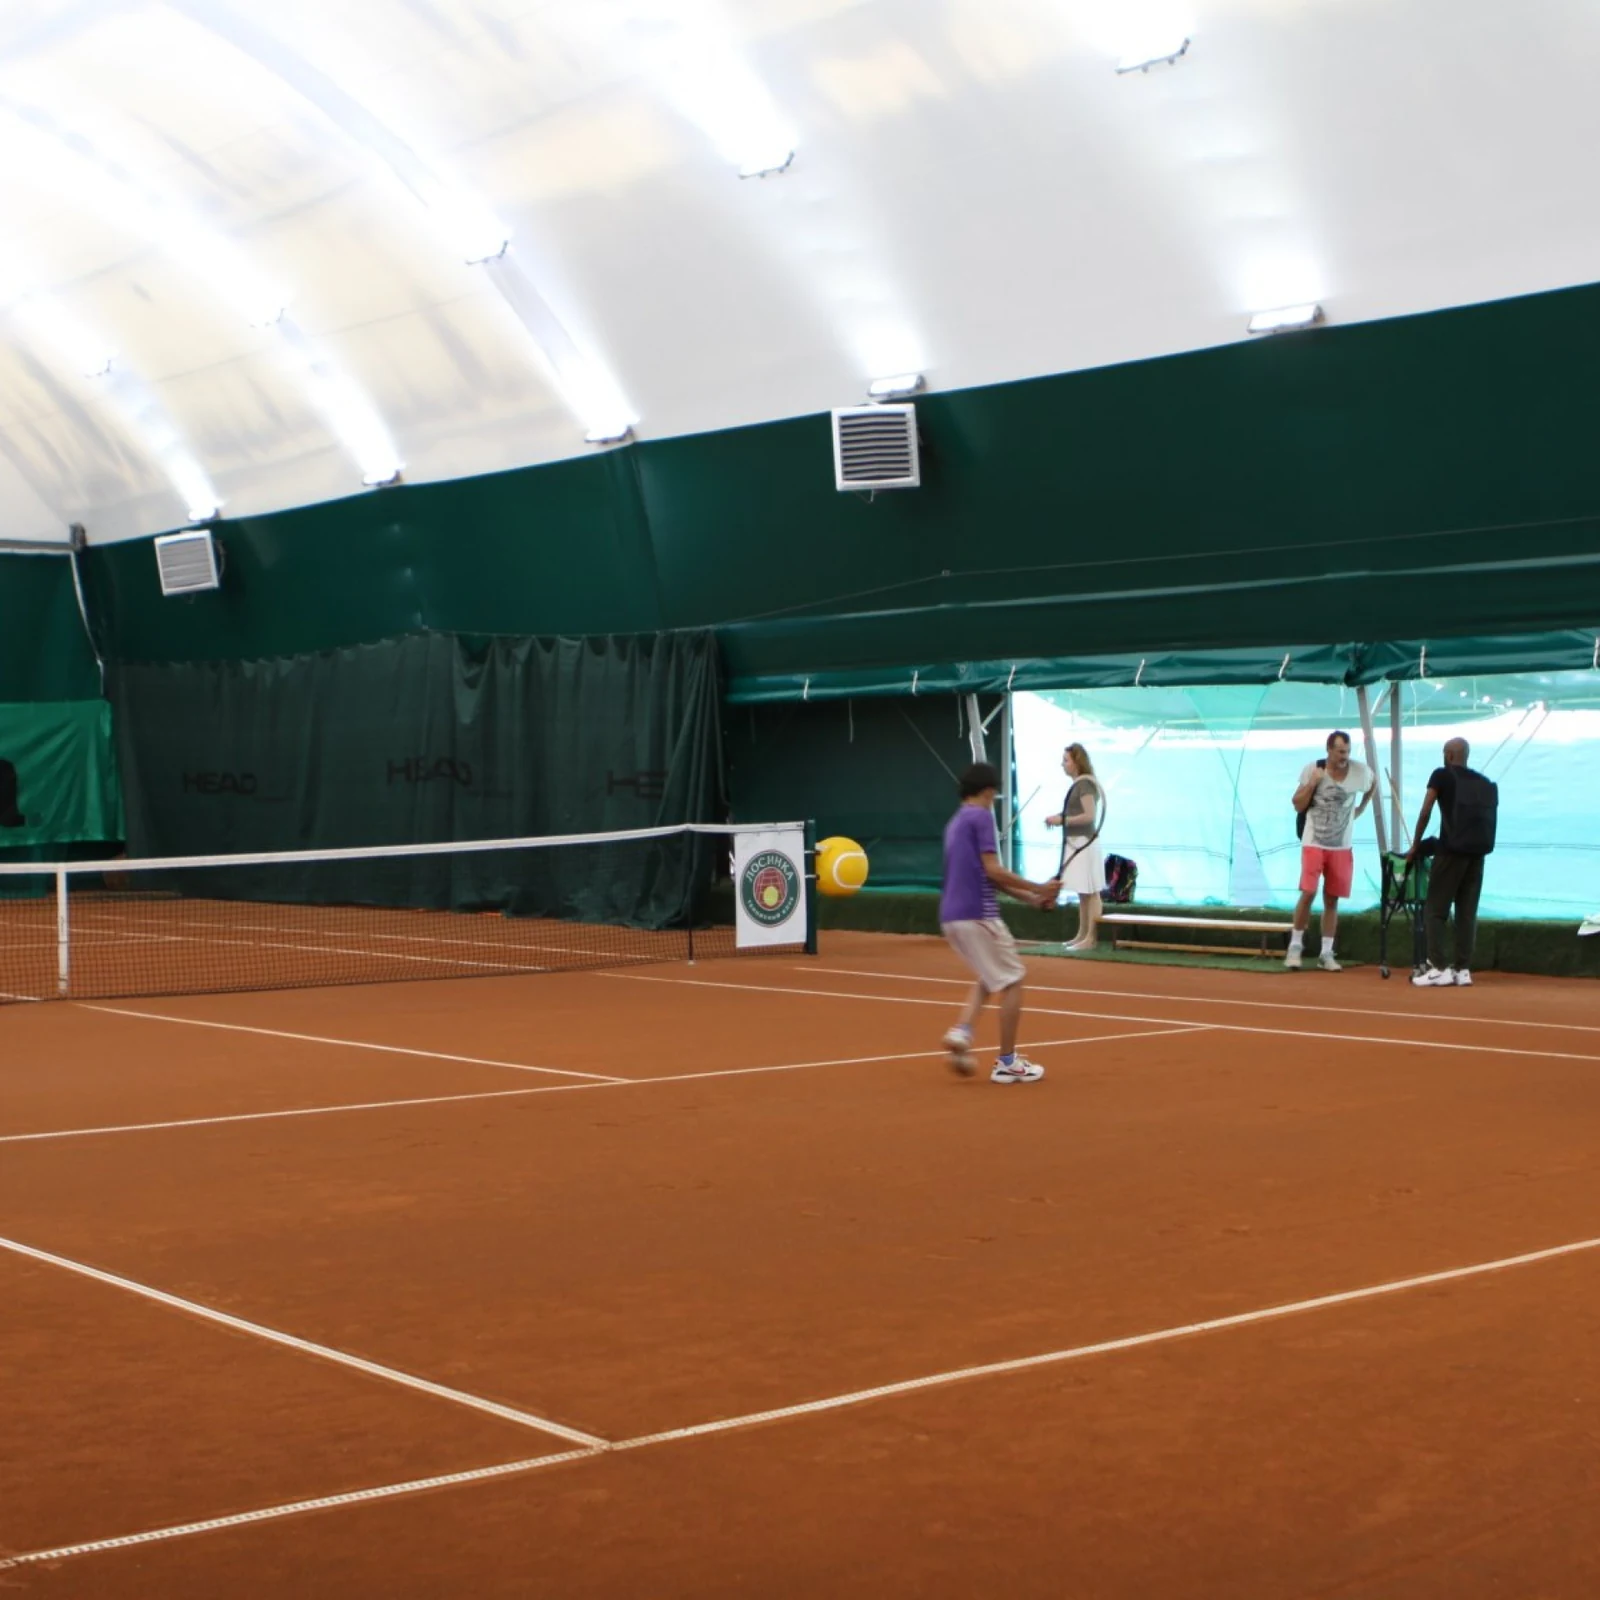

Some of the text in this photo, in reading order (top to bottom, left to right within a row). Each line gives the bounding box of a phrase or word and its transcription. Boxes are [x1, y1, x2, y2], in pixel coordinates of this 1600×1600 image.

[182, 771, 258, 794] HEAD
[386, 756, 473, 786] HEAD
[746, 854, 794, 882] ЛОСИНКА
